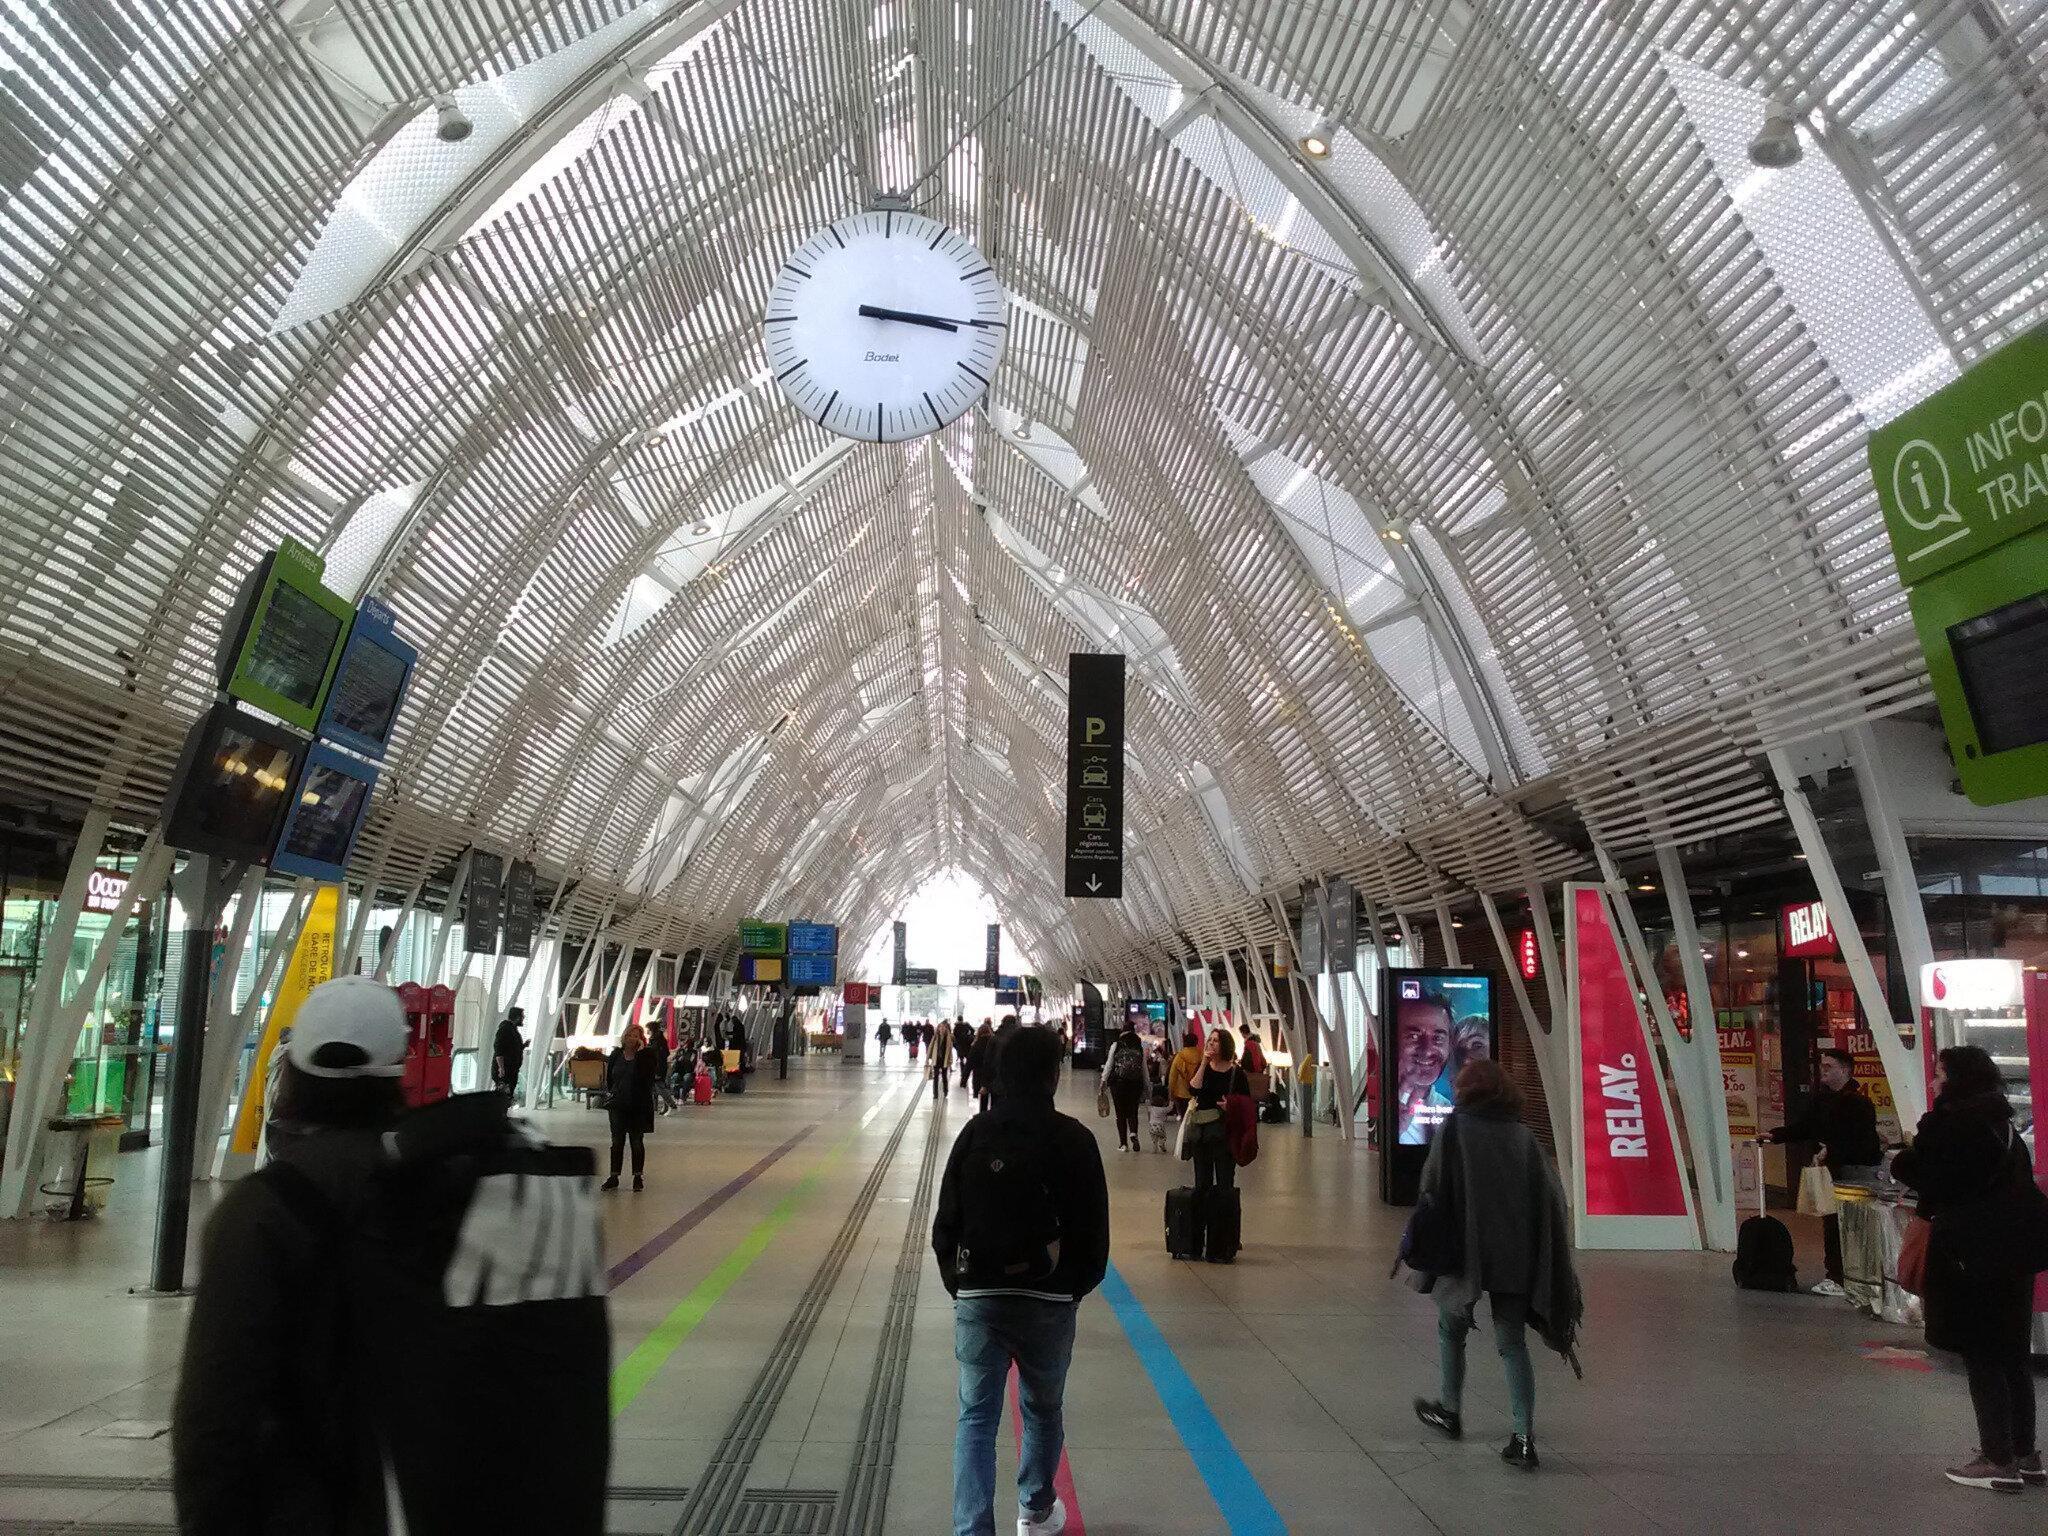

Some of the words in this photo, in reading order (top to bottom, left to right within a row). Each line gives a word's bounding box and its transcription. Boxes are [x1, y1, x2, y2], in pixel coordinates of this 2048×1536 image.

[864, 351, 899, 362] Bodet
[1965, 389, 2048, 474] INFO
[1977, 453, 2048, 520] TRA
[1086, 717, 1106, 743] P
[1789, 901, 1828, 947] RELAY
[319, 932, 330, 984] RETROUVE
[1525, 931, 1535, 974] TABAC
[1717, 1031, 1747, 1049] ELAY
[1599, 1062, 1649, 1158] RELAY
